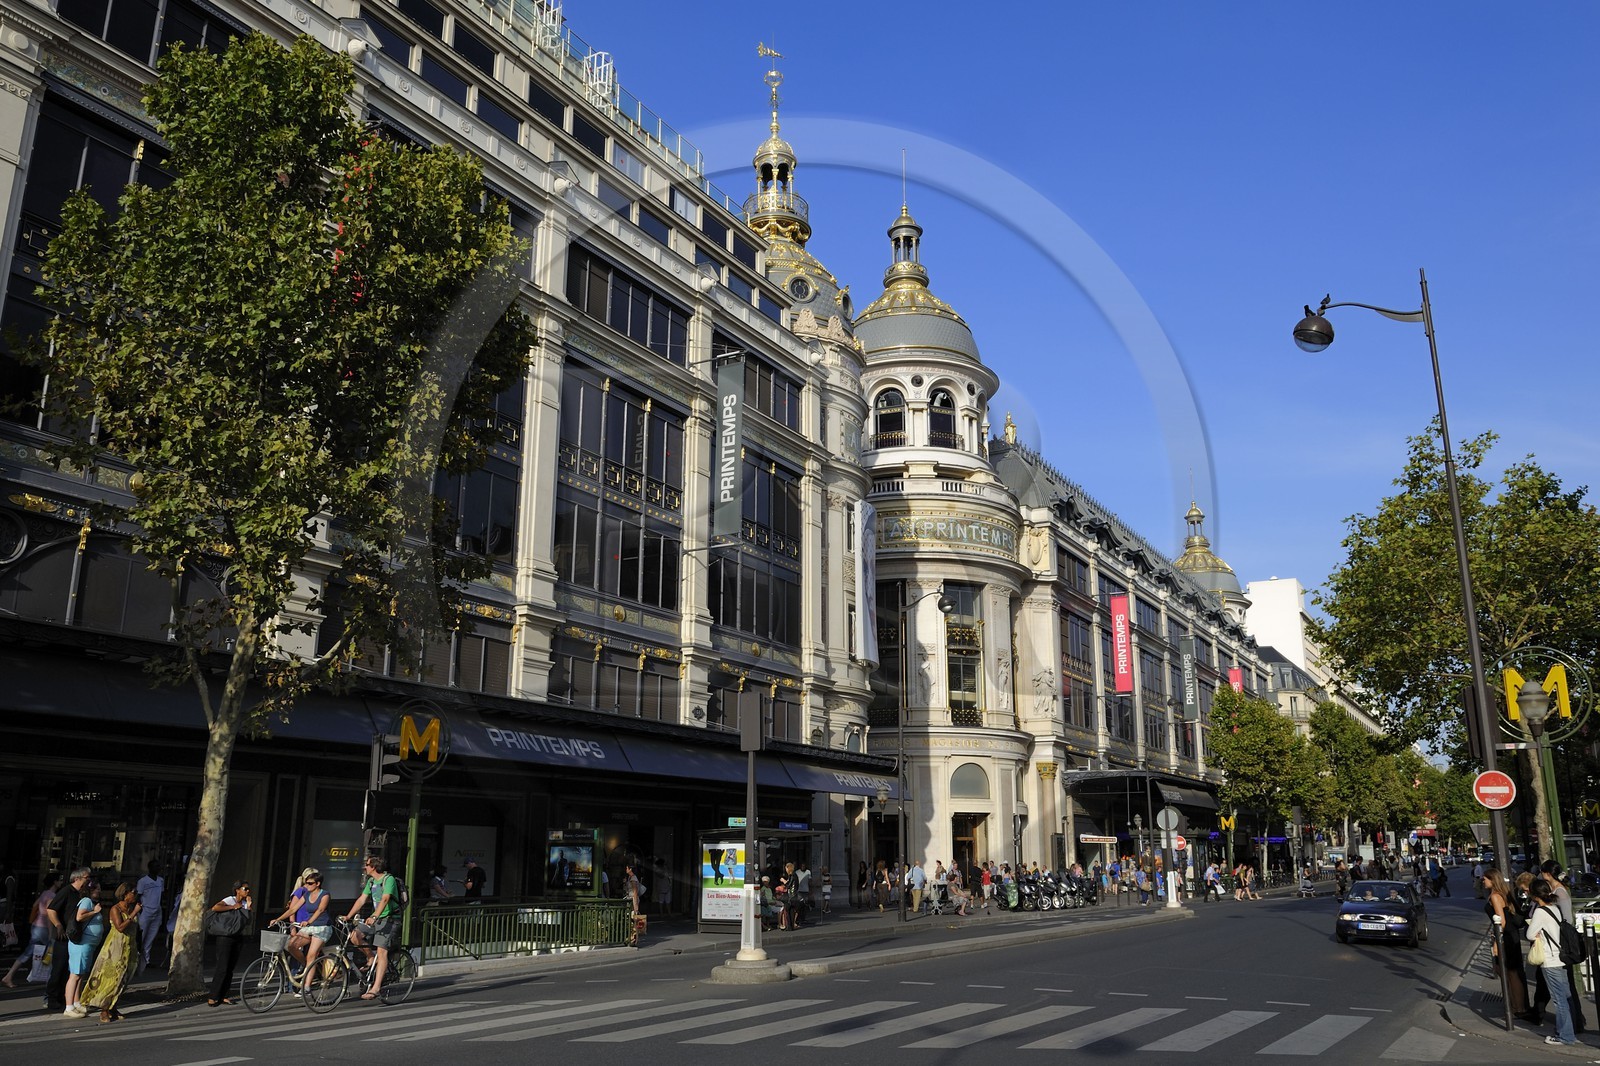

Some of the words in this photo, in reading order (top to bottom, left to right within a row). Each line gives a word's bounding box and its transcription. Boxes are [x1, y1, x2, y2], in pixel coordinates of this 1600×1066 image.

[720, 393, 737, 503] PRINTEMPS
[923, 522, 1013, 549] PRINTEMPS
[1115, 614, 1128, 674] PRINTEMPS
[1183, 653, 1195, 705] PRINTEMPS
[1502, 663, 1572, 723] M
[399, 715, 440, 762] M
[485, 727, 606, 759] PRINTEMPS
[832, 772, 893, 791] PRINTEMPS
[1220, 815, 1235, 831] M
